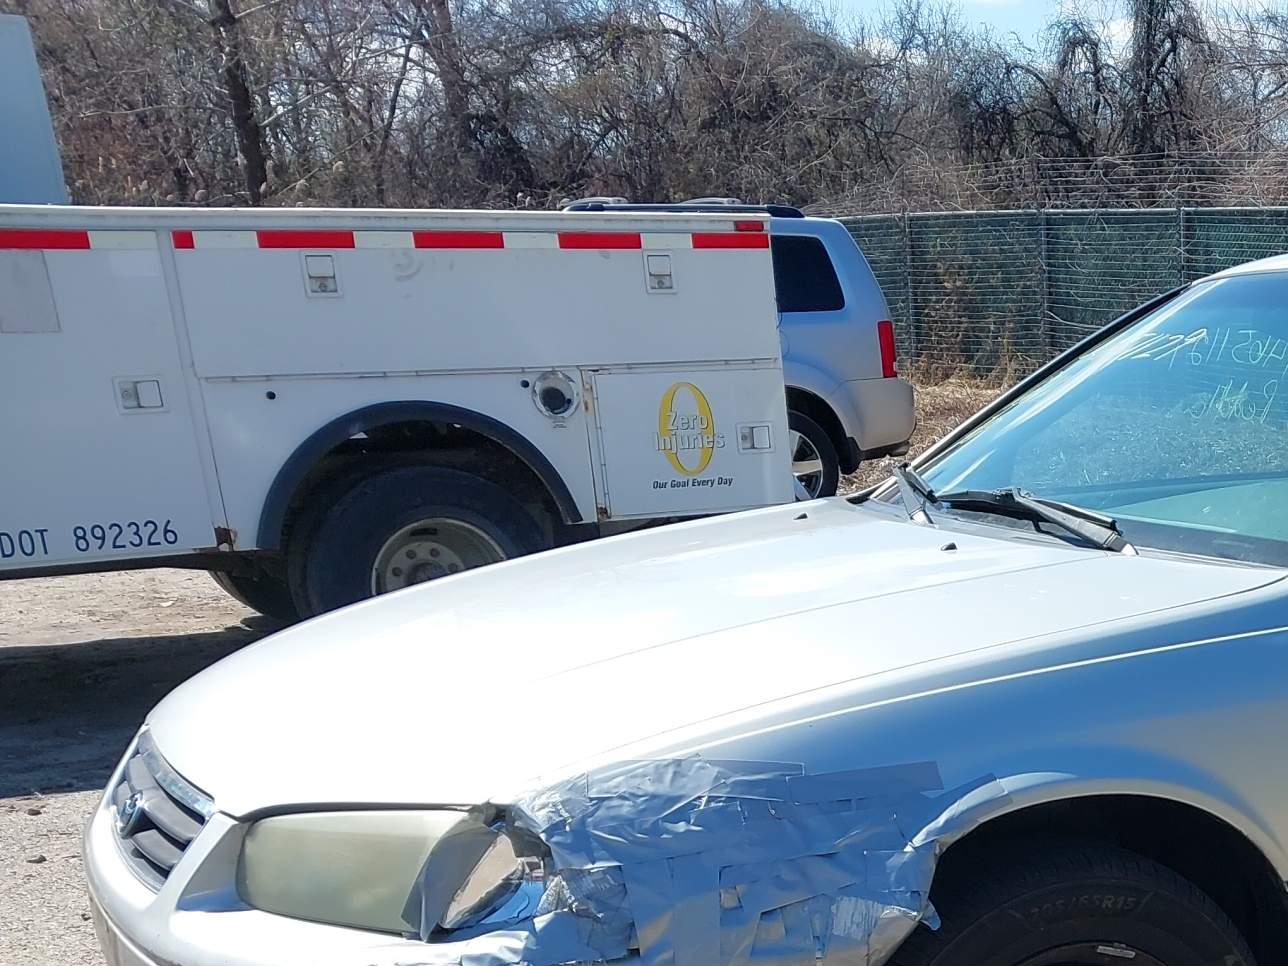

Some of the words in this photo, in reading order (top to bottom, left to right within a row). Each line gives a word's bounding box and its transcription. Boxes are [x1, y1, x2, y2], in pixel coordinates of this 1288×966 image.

[666, 411, 709, 431] Zero
[655, 432, 726, 453] Injuries
[653, 481, 668, 489] Our
[670, 479, 689, 489] Goal
[691, 478, 716, 489] Every
[717, 477, 733, 486] Day
[0, 529, 49, 558] DOT
[73, 519, 179, 552] 892326
